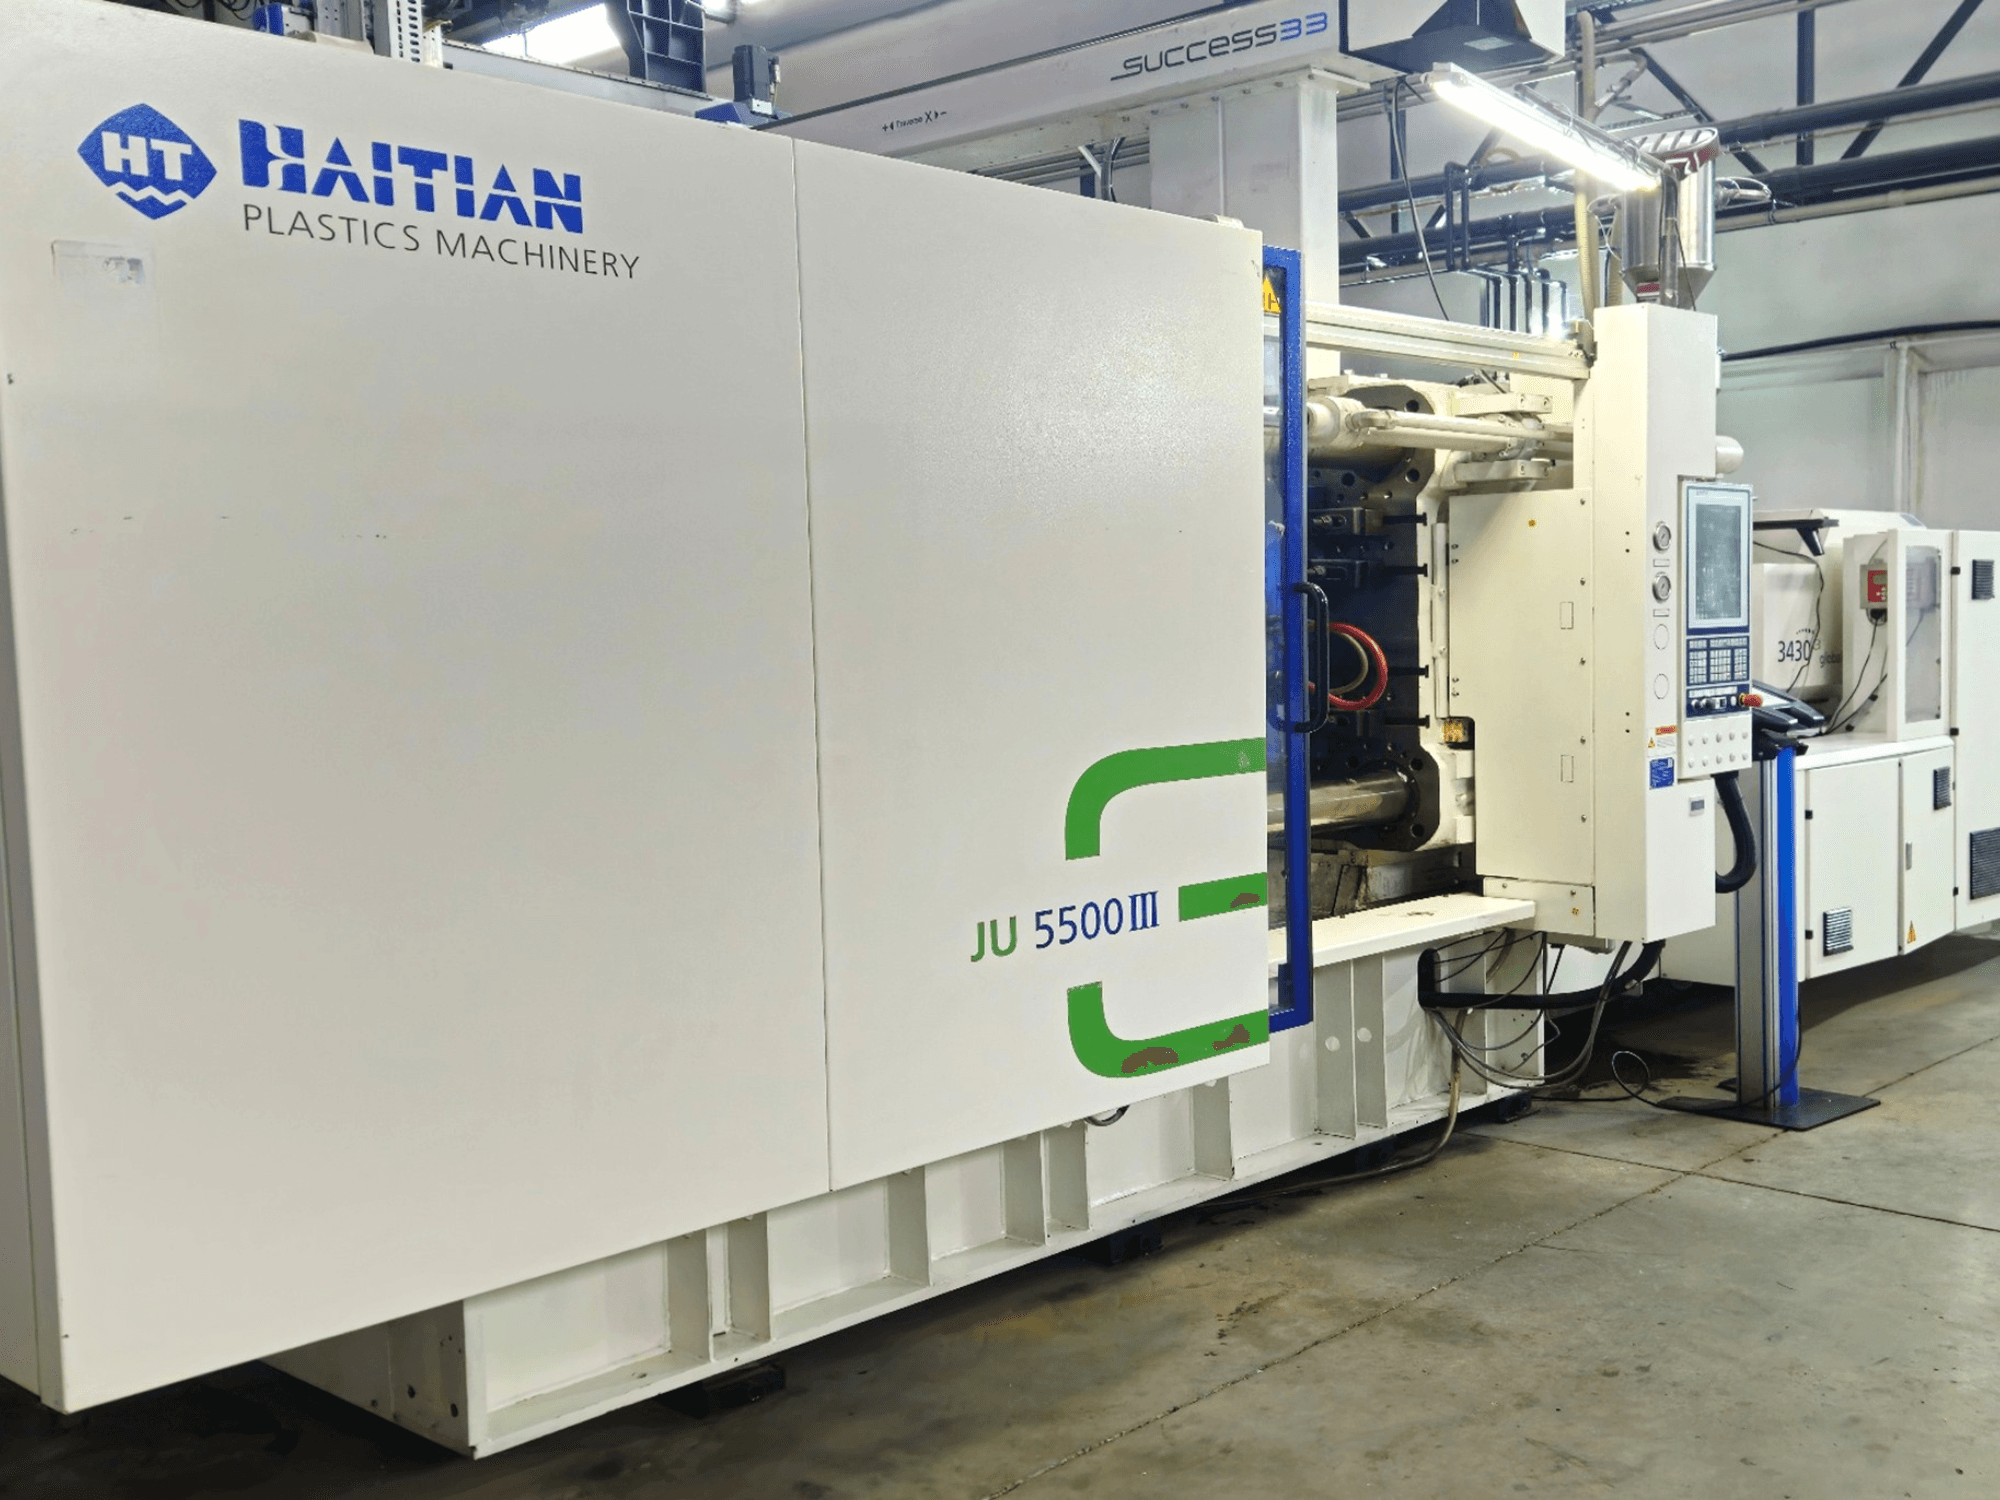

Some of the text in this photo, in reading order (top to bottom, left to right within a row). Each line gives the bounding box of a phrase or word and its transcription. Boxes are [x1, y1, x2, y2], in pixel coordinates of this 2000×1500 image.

[924, 110, 933, 124] X
[101, 130, 193, 182] HT
[238, 118, 584, 235] HAITIAN
[243, 203, 640, 279] PLASTICS MACHINERY
[1777, 639, 1811, 663] 3430
[970, 915, 1017, 963] JU
